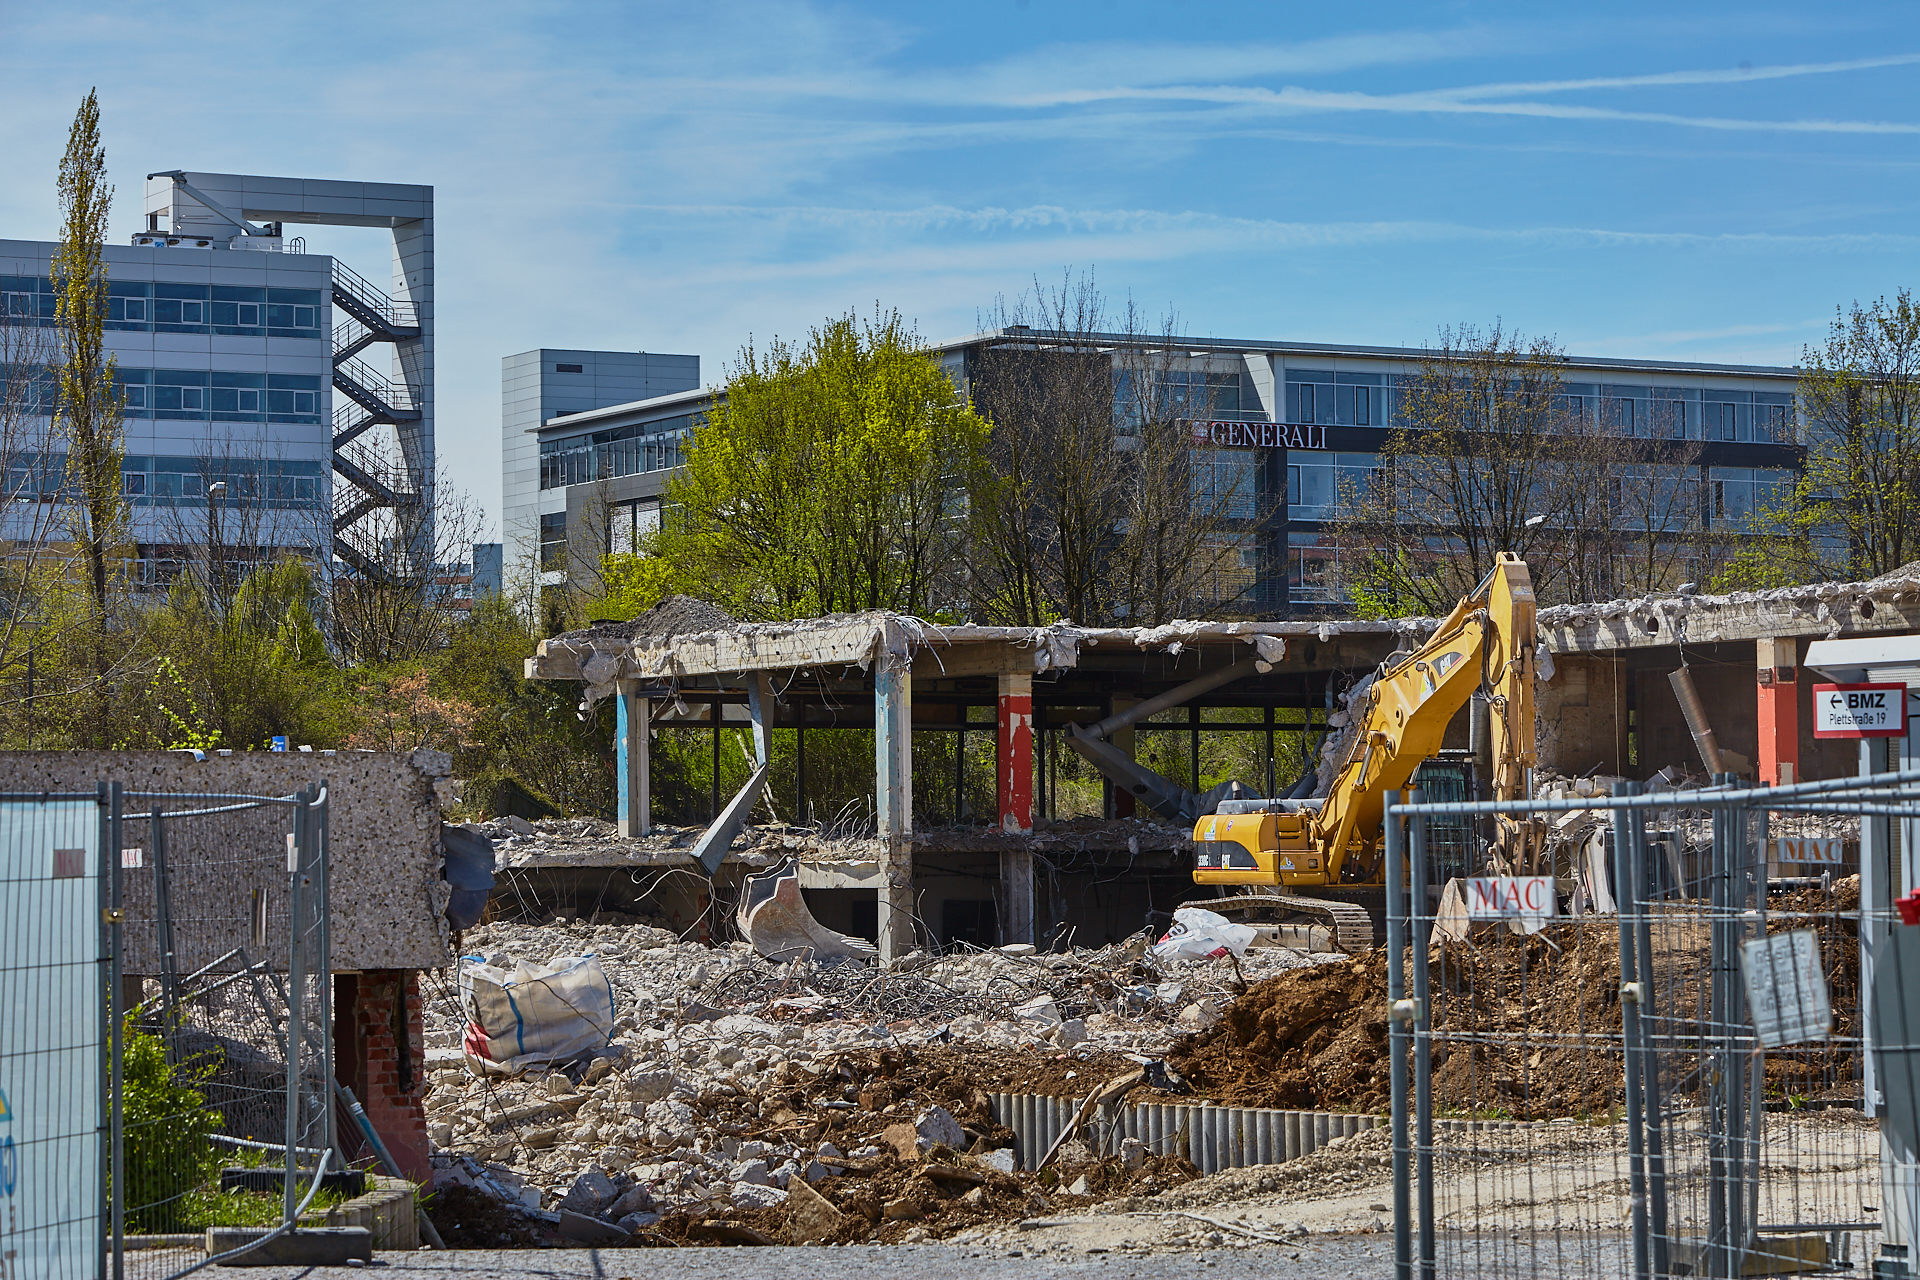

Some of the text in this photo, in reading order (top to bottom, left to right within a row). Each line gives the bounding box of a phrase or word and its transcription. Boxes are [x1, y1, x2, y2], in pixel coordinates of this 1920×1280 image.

[1211, 422, 1327, 449] GENERALI
[1848, 693, 1885, 708] BMZ
[1830, 712, 1887, 725] Plettstraße 19
[123, 850, 139, 865] MAC
[1784, 840, 1840, 861] MAC
[57, 852, 84, 875] MAC
[1475, 879, 1546, 910] MAC
